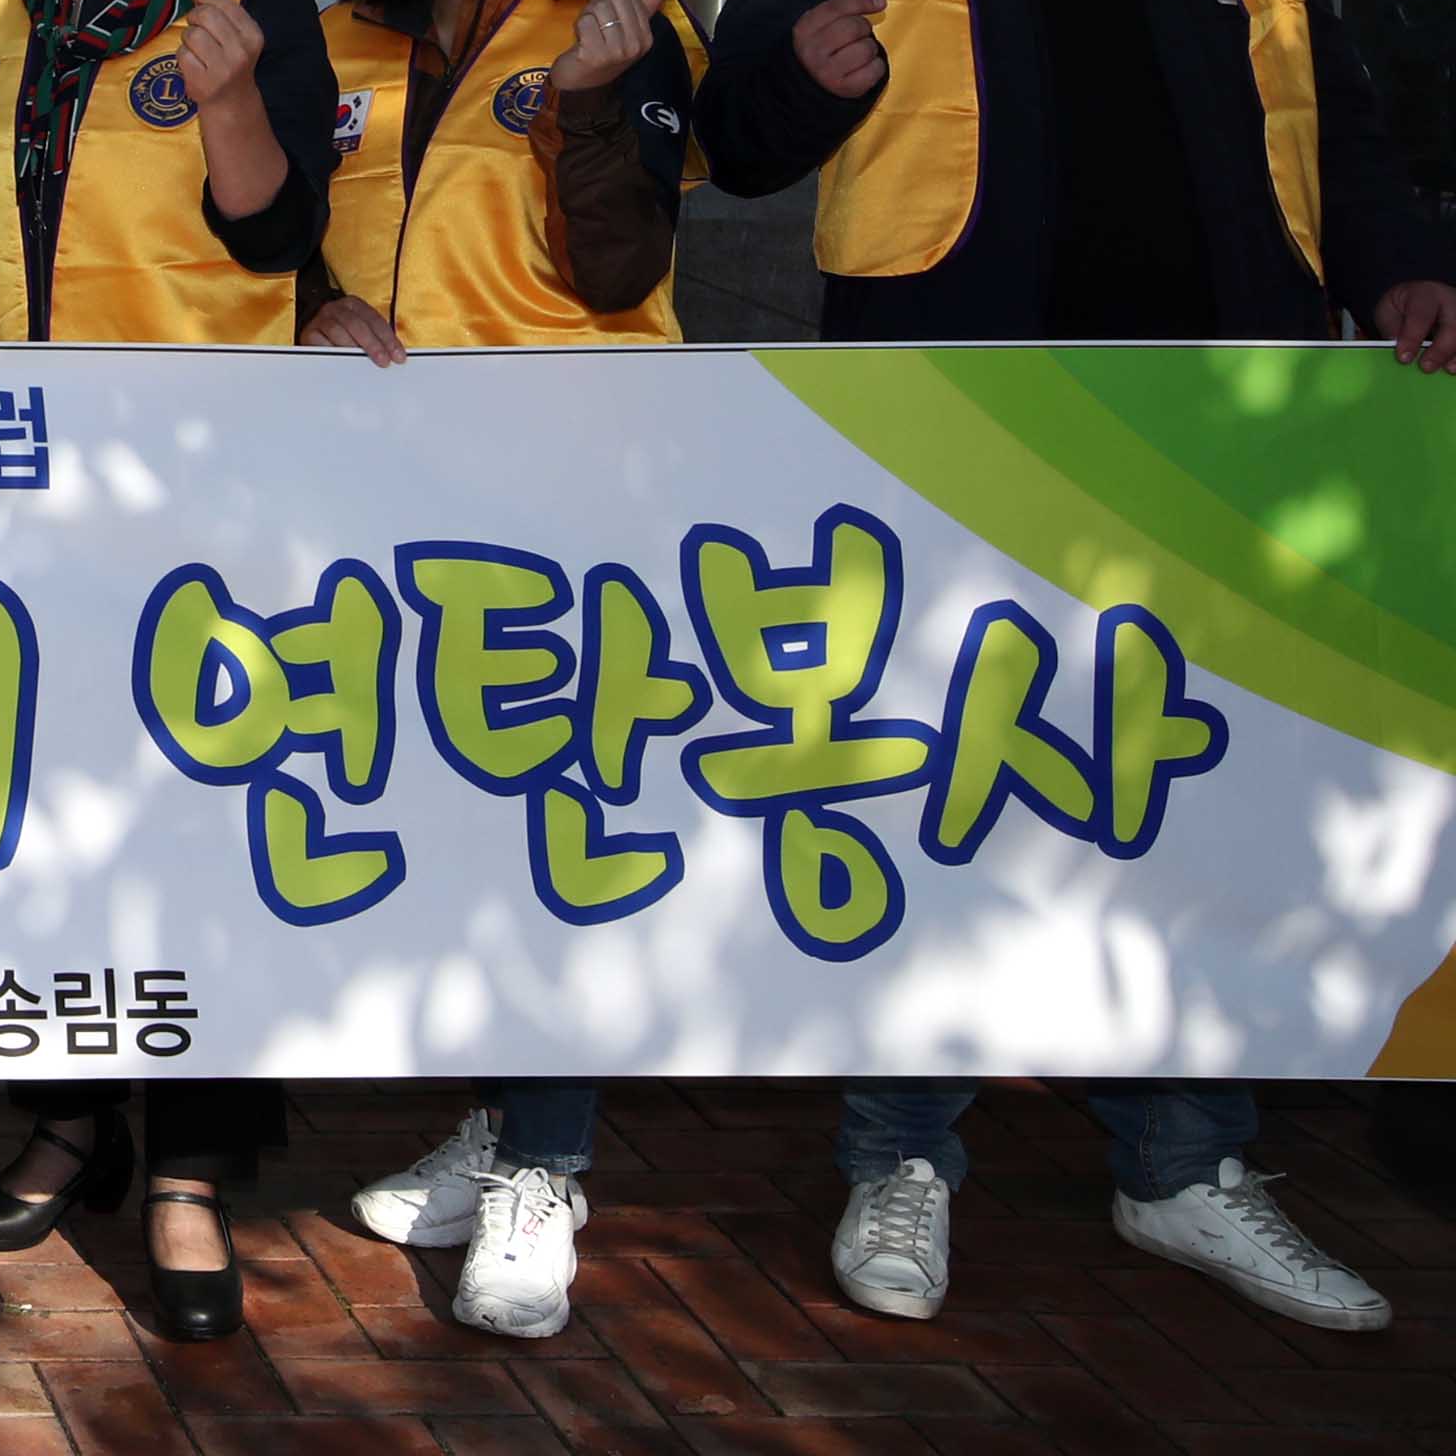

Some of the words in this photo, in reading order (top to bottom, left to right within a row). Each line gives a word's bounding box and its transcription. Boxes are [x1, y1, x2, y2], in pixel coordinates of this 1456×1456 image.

[151, 61, 178, 73] LIO
[522, 73, 545, 82] LIO
[131, 501, 1229, 962] 연탄봉사
